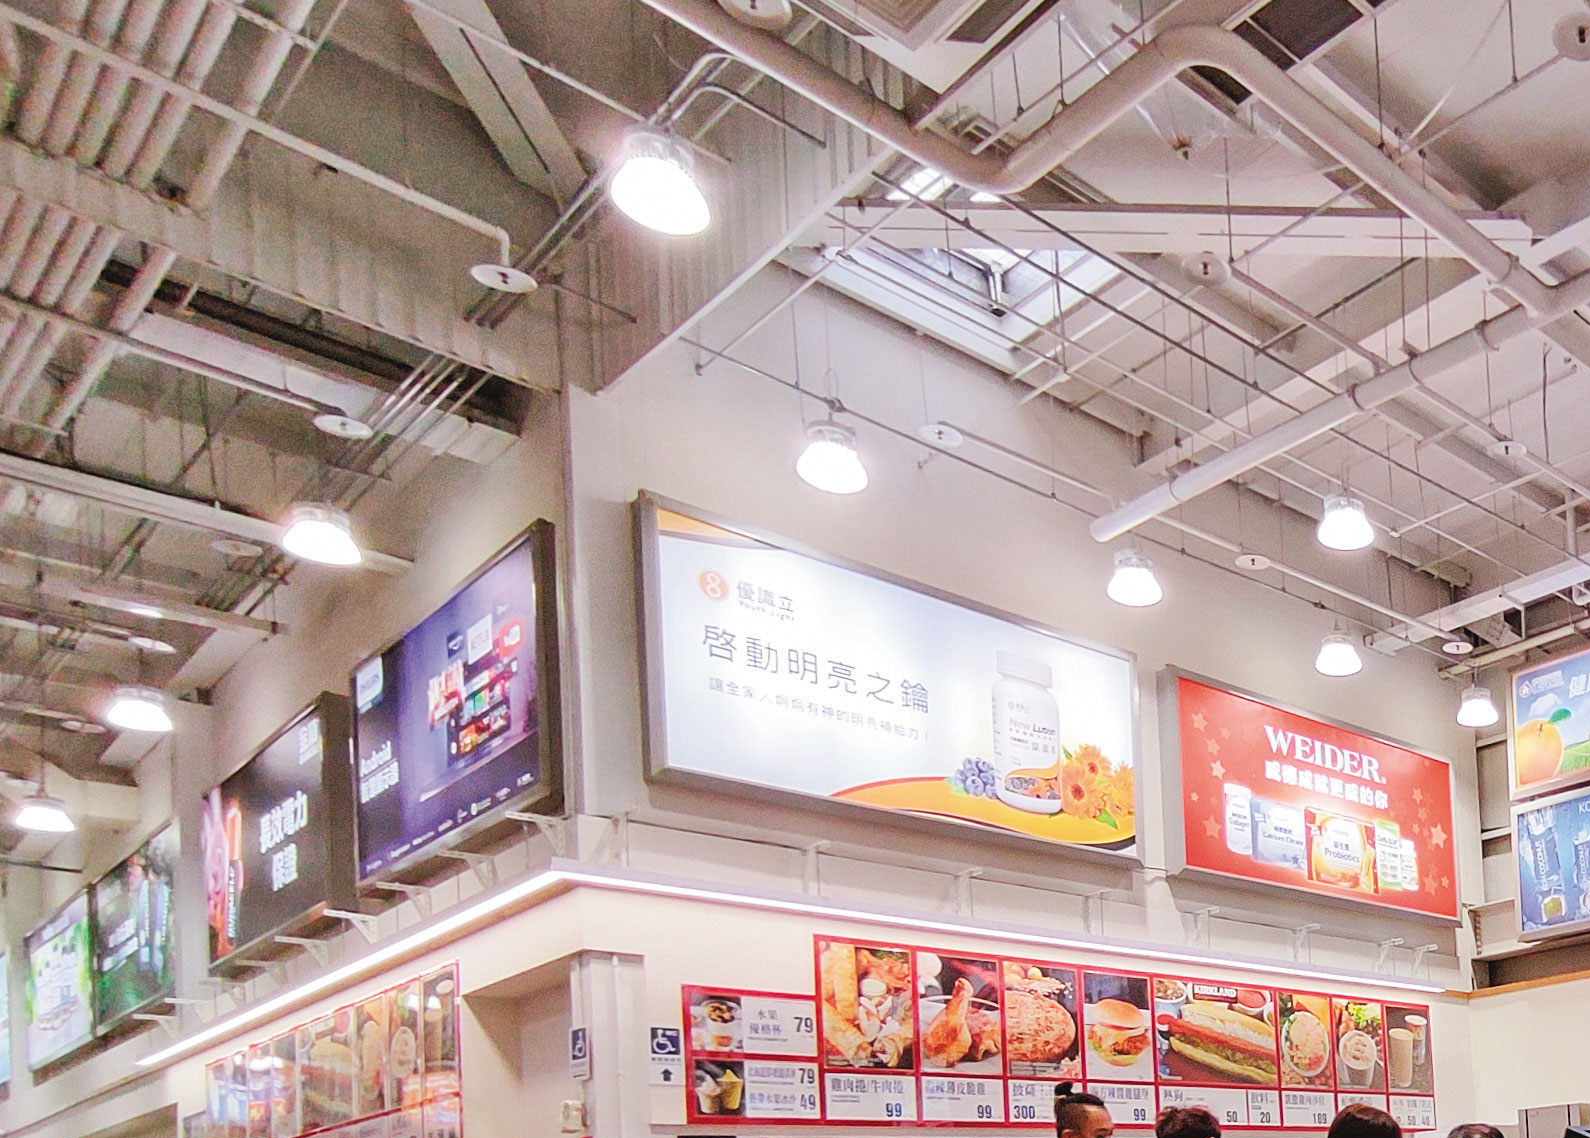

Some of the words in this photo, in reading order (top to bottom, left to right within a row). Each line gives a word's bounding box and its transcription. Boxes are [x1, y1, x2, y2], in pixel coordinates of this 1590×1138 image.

[360, 740, 392, 778] Android
[1264, 724, 1382, 785] WEIDER
[259, 790, 308, 854] 長效電力
[1324, 847, 1360, 864] Probiotics
[1194, 984, 1237, 1000] KIRKLAND
[793, 1016, 814, 1034] 79
[798, 1067, 815, 1085] 79
[799, 1093, 816, 1111] 49
[885, 1102, 902, 1118] 99
[977, 1104, 992, 1119] 99
[1013, 1105, 1036, 1119] 300
[1133, 1108, 1147, 1122] 99
[1226, 1110, 1238, 1123] 50
[1260, 1111, 1271, 1123] 20
[1312, 1113, 1328, 1125] 189
[1407, 1114, 1416, 1126] 50
[1421, 1115, 1431, 1126] 40
